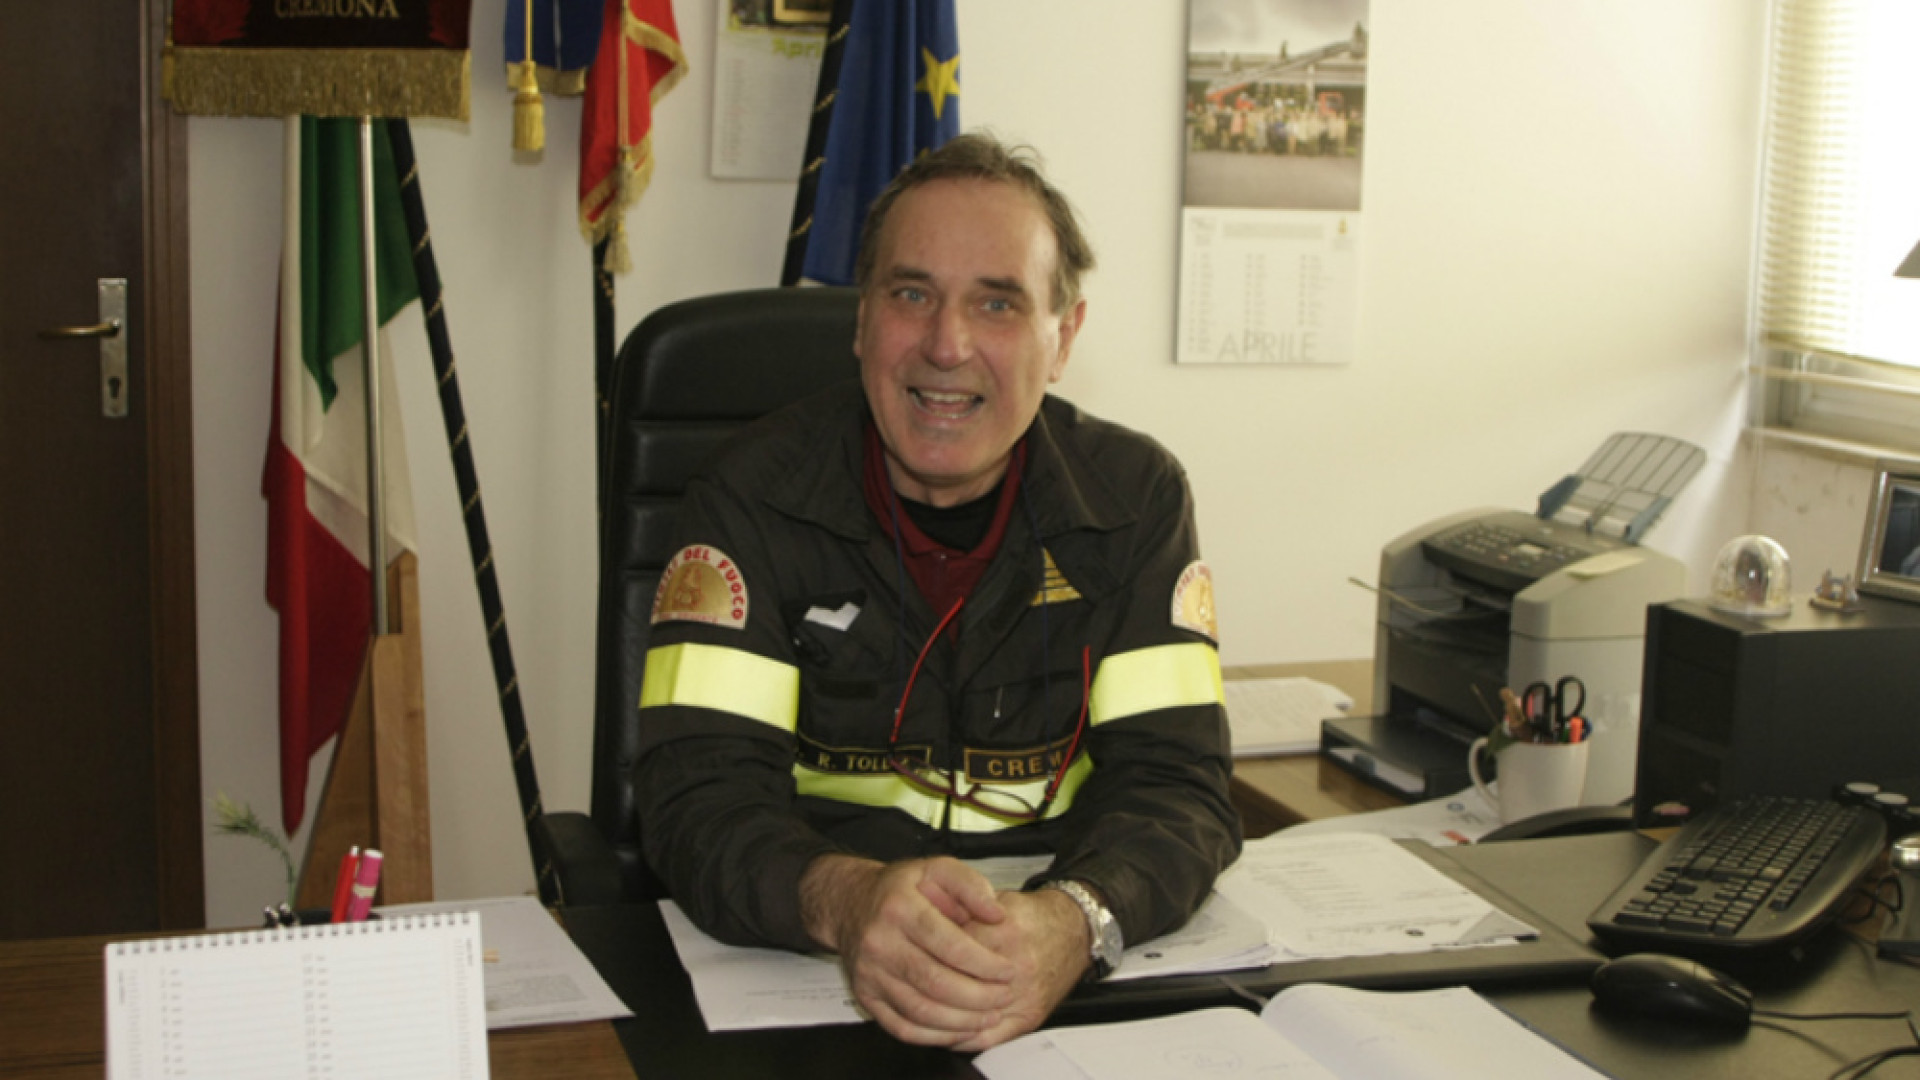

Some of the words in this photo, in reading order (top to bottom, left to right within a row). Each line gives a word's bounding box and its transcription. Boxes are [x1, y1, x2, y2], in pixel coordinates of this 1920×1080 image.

[772, 37, 822, 59] Apri
[1216, 330, 1317, 361] APRILE
[683, 548, 710, 561] DEL
[716, 559, 745, 620] FUOCO
[987, 749, 1062, 776] CREM
